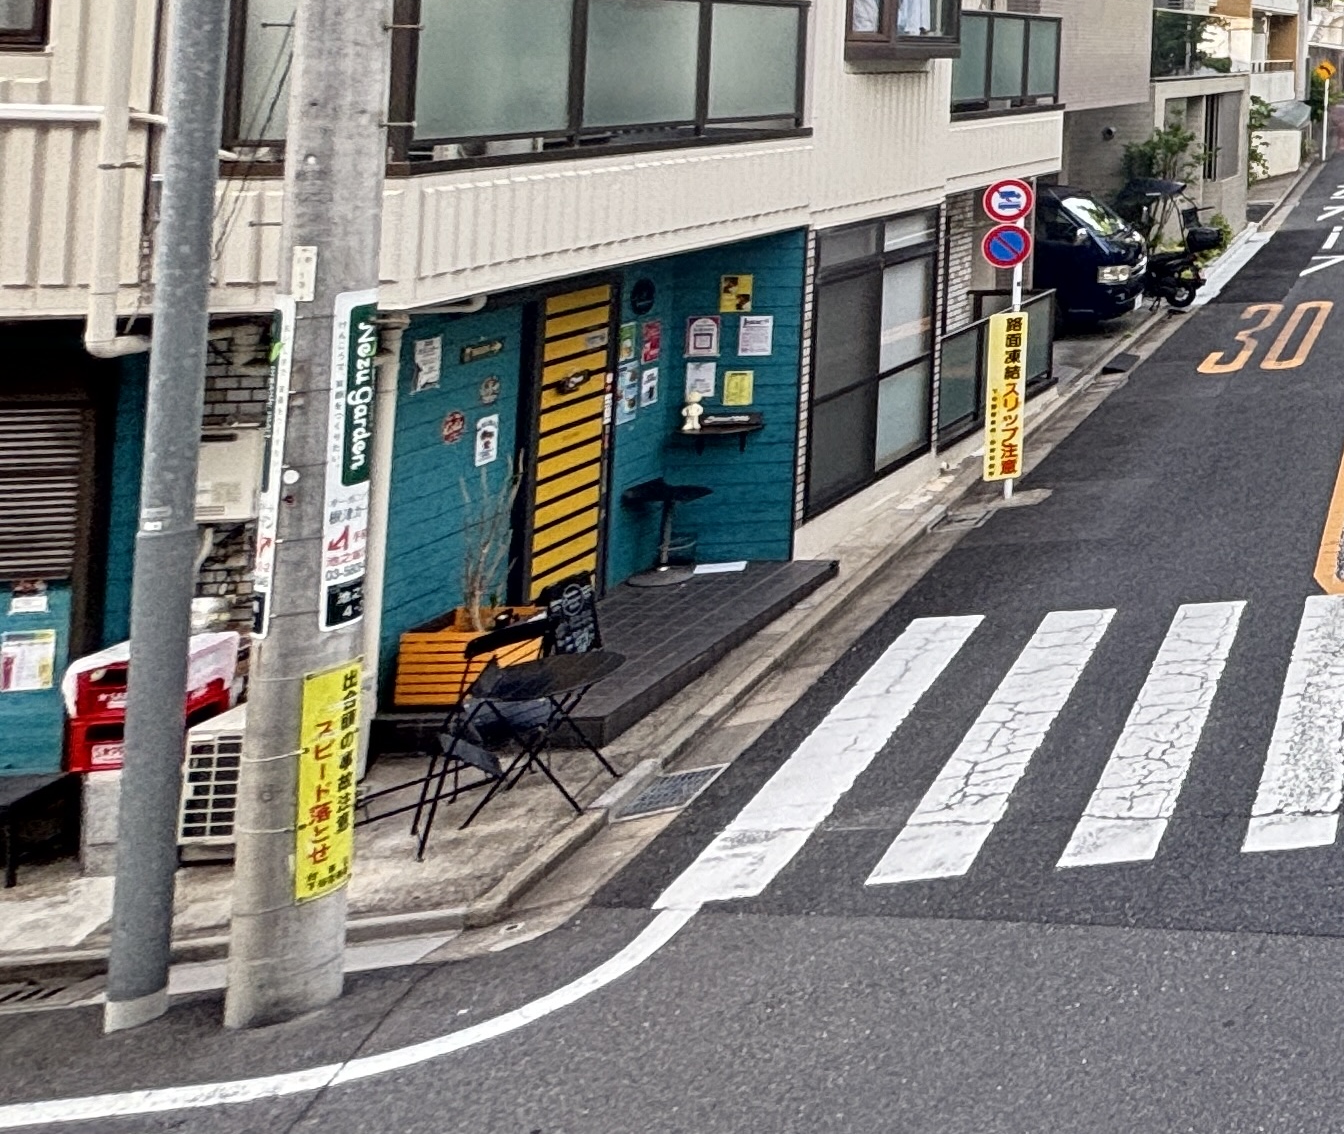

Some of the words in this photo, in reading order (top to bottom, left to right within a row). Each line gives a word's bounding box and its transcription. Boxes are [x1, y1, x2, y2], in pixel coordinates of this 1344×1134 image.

[355, 322, 378, 384] Nezu
[1197, 301, 1334, 374] 30
[348, 386, 373, 470] garden
[1000, 317, 1023, 475] 路面凍結スリップ注意
[308, 720, 335, 864] スピード落とせ
